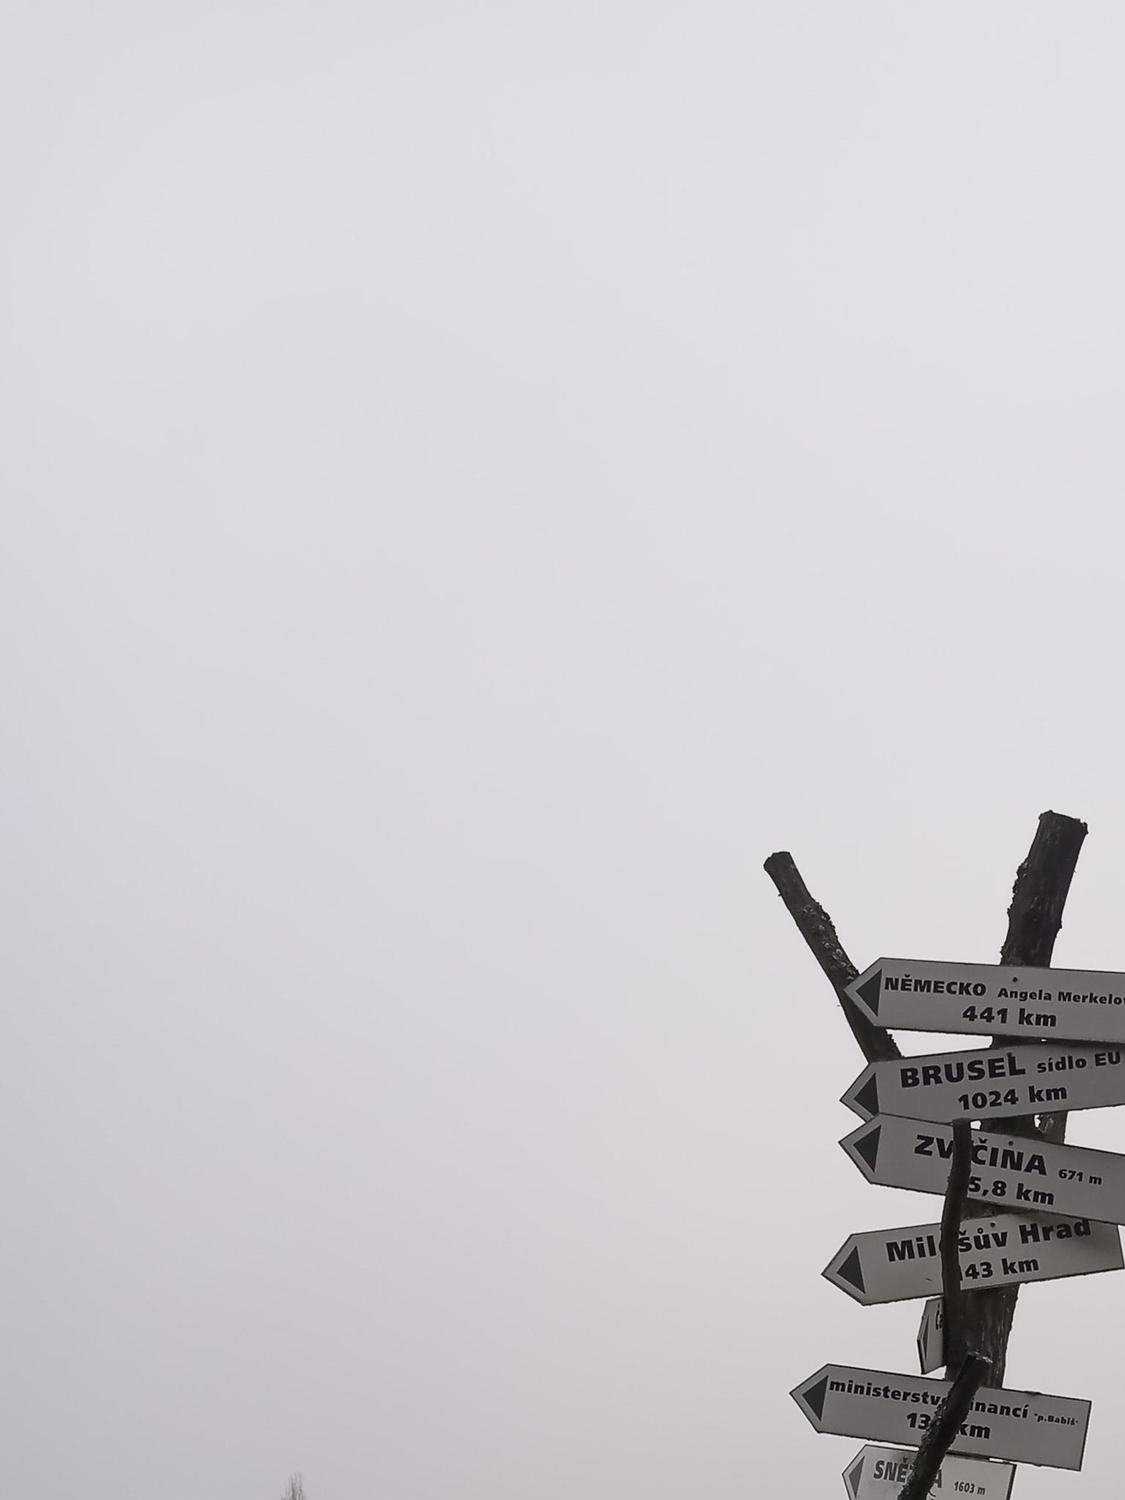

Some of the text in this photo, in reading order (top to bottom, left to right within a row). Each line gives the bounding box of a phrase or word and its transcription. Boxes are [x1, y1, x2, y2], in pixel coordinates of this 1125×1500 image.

[884, 974, 987, 997] NĚMECKO
[998, 987, 1052, 1002] Angela
[962, 1006, 1057, 1027] 441 km
[900, 1051, 1122, 1089] BRUSEL sídlo EU
[958, 1086, 1068, 1111] 1024 km
[914, 1134, 1103, 1186] ZVČINA 671 m
[1016, 1182, 1055, 1206] km
[886, 1219, 1091, 1263] Milšův Hrad
[1001, 1258, 1040, 1276] km
[829, 1380, 946, 1408] ministerstv
[969, 1402, 1028, 1419] inancí
[873, 1457, 986, 1496] SNĚA 1603 m
